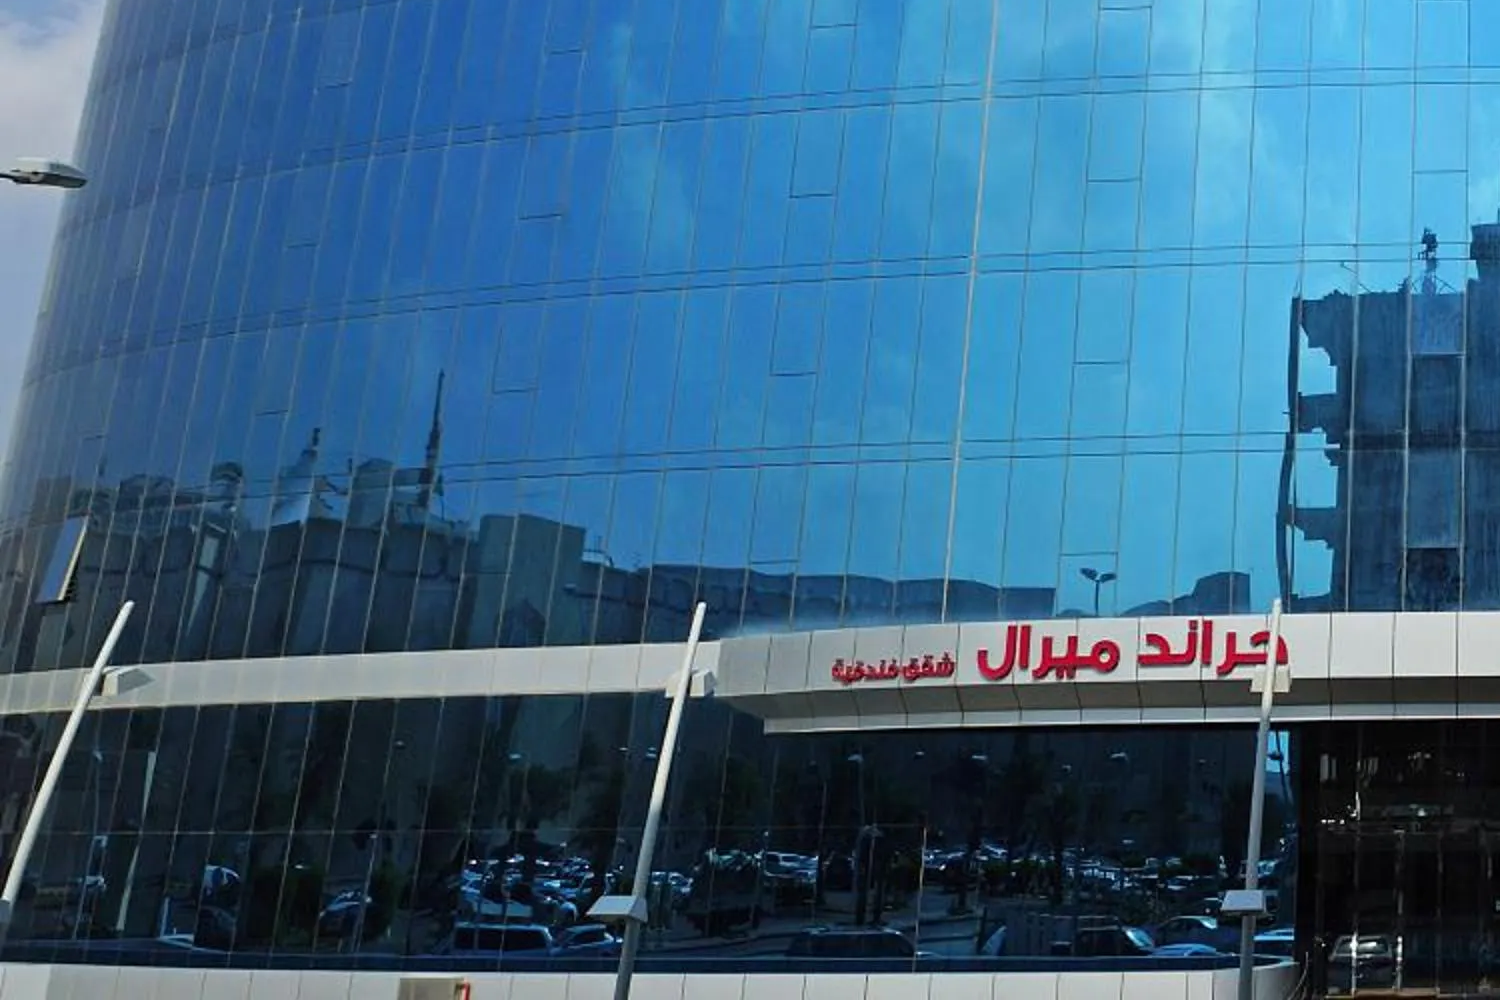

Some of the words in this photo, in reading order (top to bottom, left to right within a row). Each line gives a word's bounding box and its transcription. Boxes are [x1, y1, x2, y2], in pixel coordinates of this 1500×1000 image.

[902, 651, 956, 683] شقق
[977, 624, 1121, 681] ميرال
[831, 658, 900, 685] فندقية
